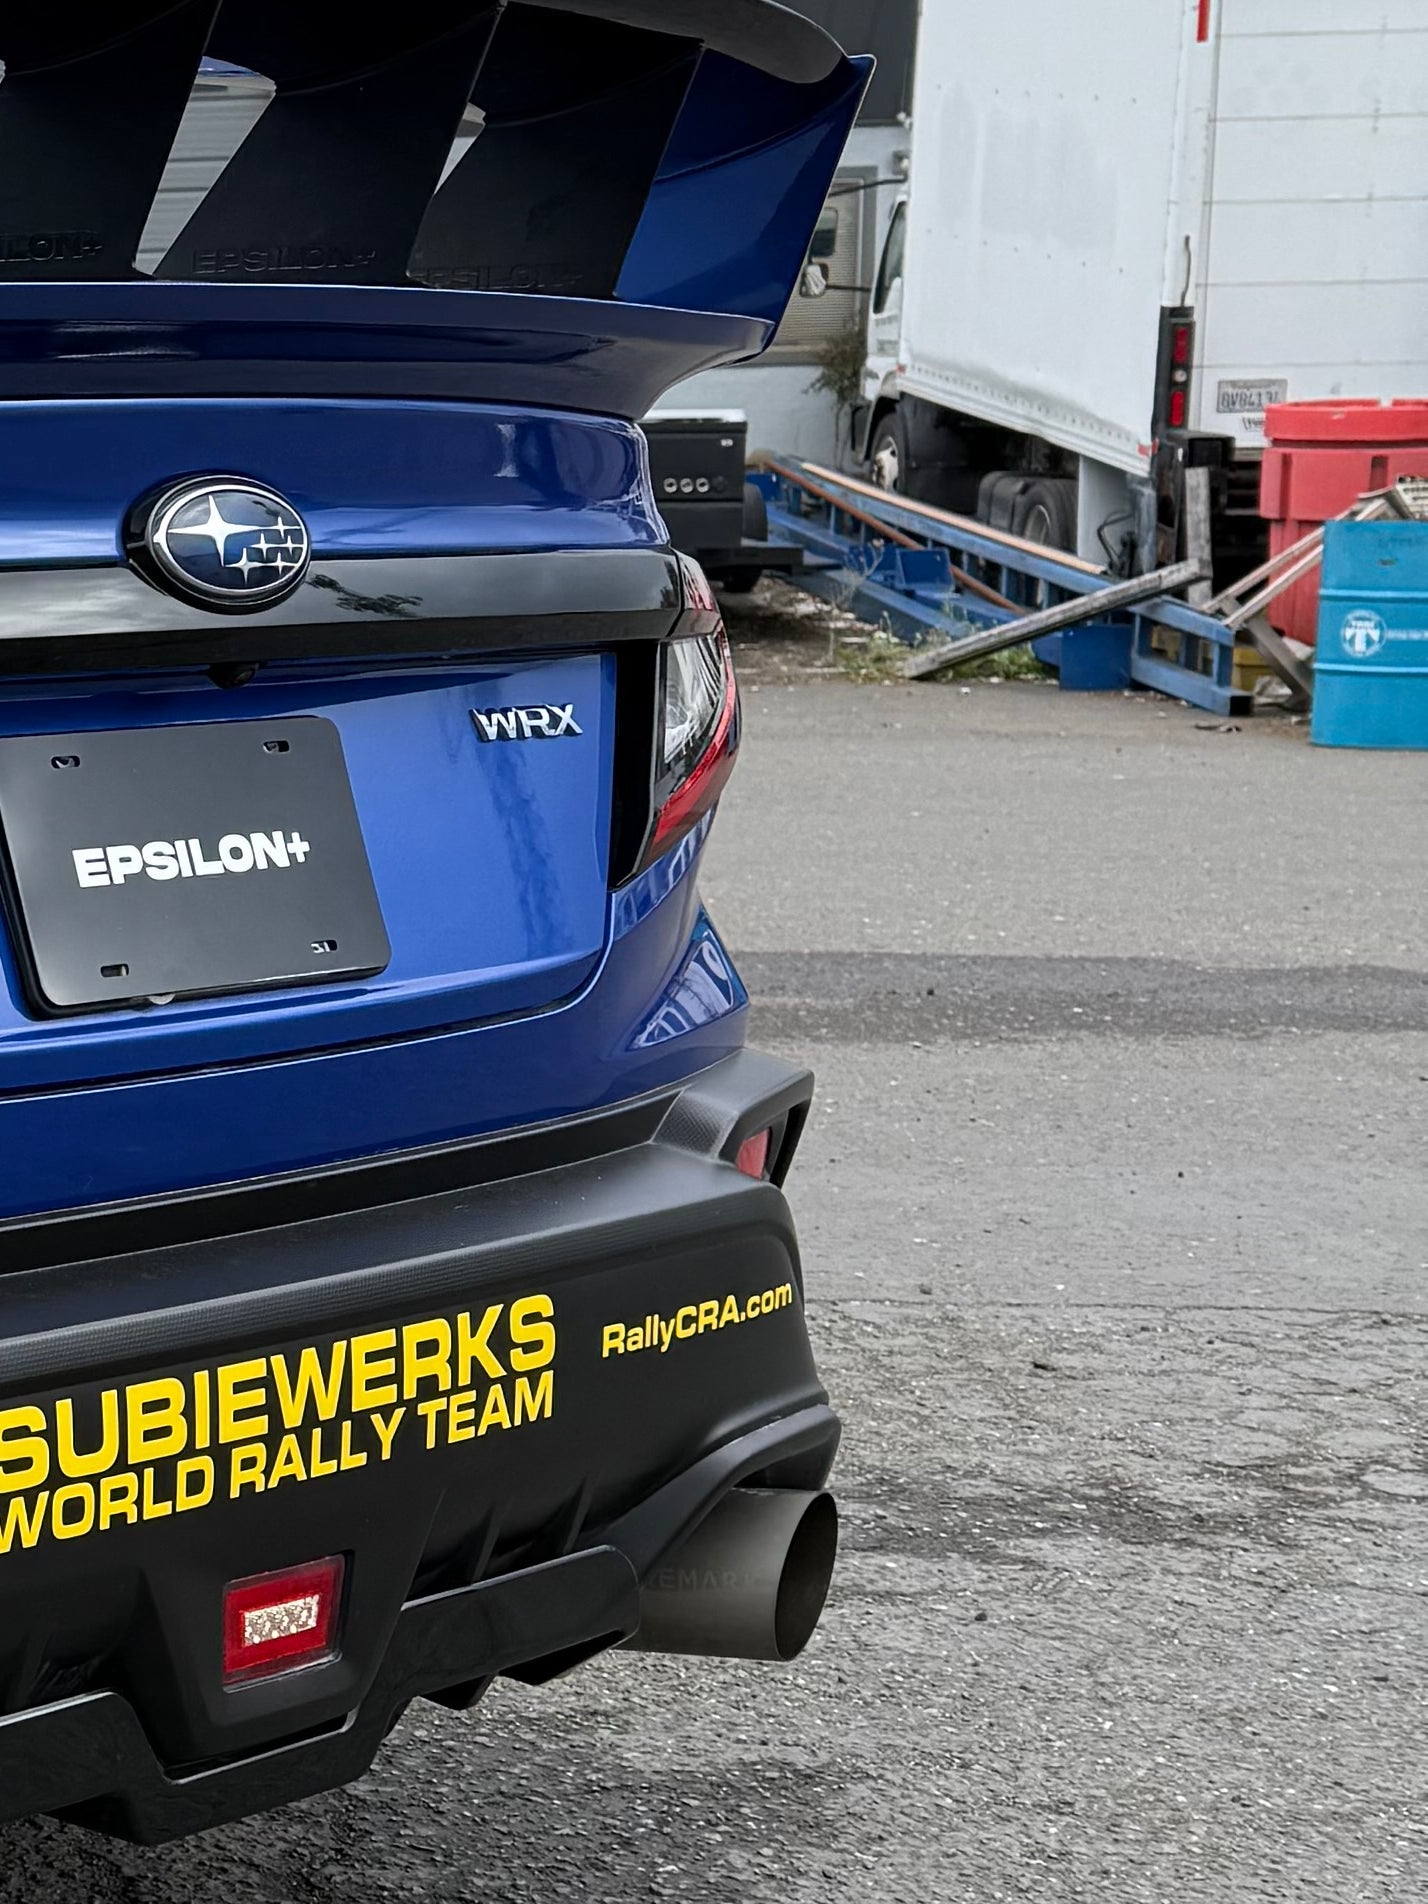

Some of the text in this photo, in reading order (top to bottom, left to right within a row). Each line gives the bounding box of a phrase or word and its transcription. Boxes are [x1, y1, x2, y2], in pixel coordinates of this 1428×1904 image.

[192, 242, 377, 274] EPSILON+
[471, 702, 584, 741] WRX
[73, 829, 312, 888] EPSILON+
[601, 1284, 792, 1357] RallyCRA.com
[228, 1407, 403, 1500] RALLY
[417, 1369, 555, 1449] TEAM
